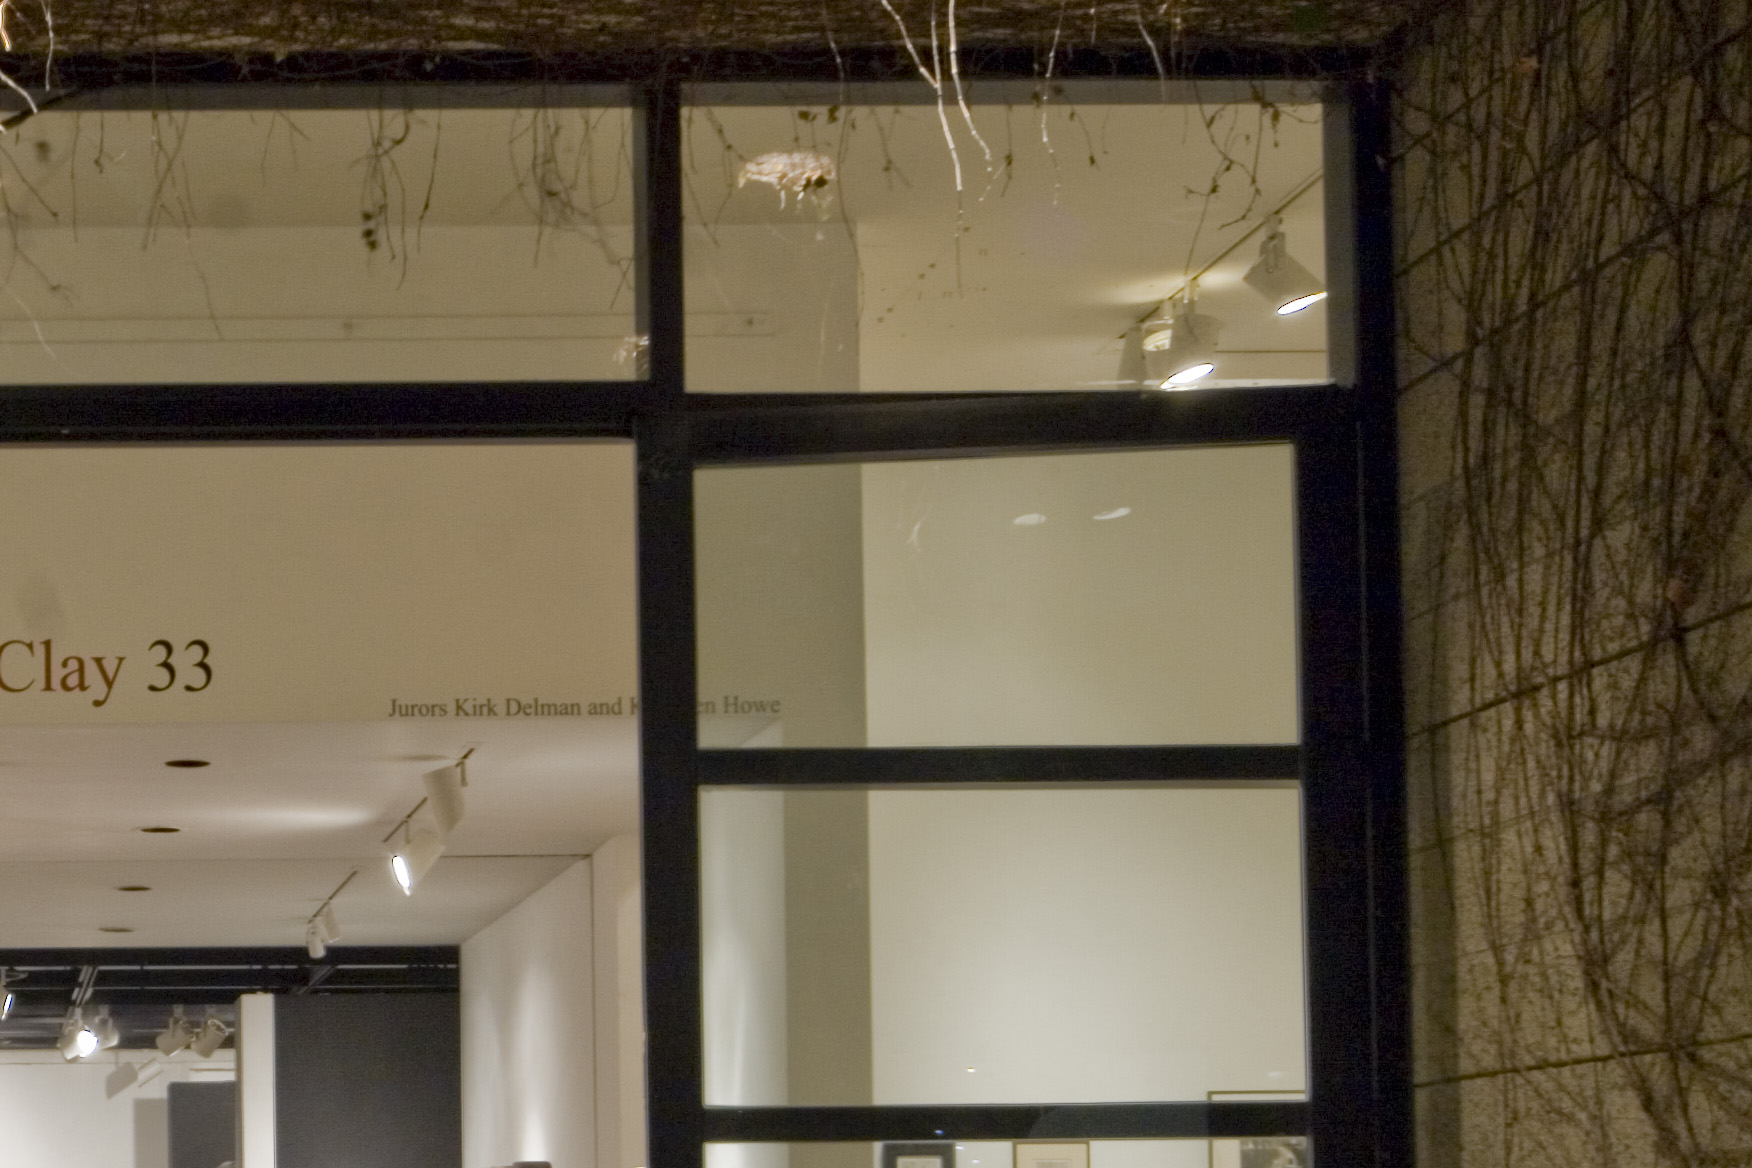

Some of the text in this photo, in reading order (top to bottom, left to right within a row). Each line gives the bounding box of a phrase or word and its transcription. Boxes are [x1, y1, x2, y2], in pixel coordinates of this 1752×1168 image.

[146, 638, 214, 693] 33
[387, 698, 448, 718] Jurors
[454, 697, 499, 717] Kirk
[505, 696, 582, 717] Delman
[587, 696, 623, 716] and
[723, 695, 781, 714] Howe
